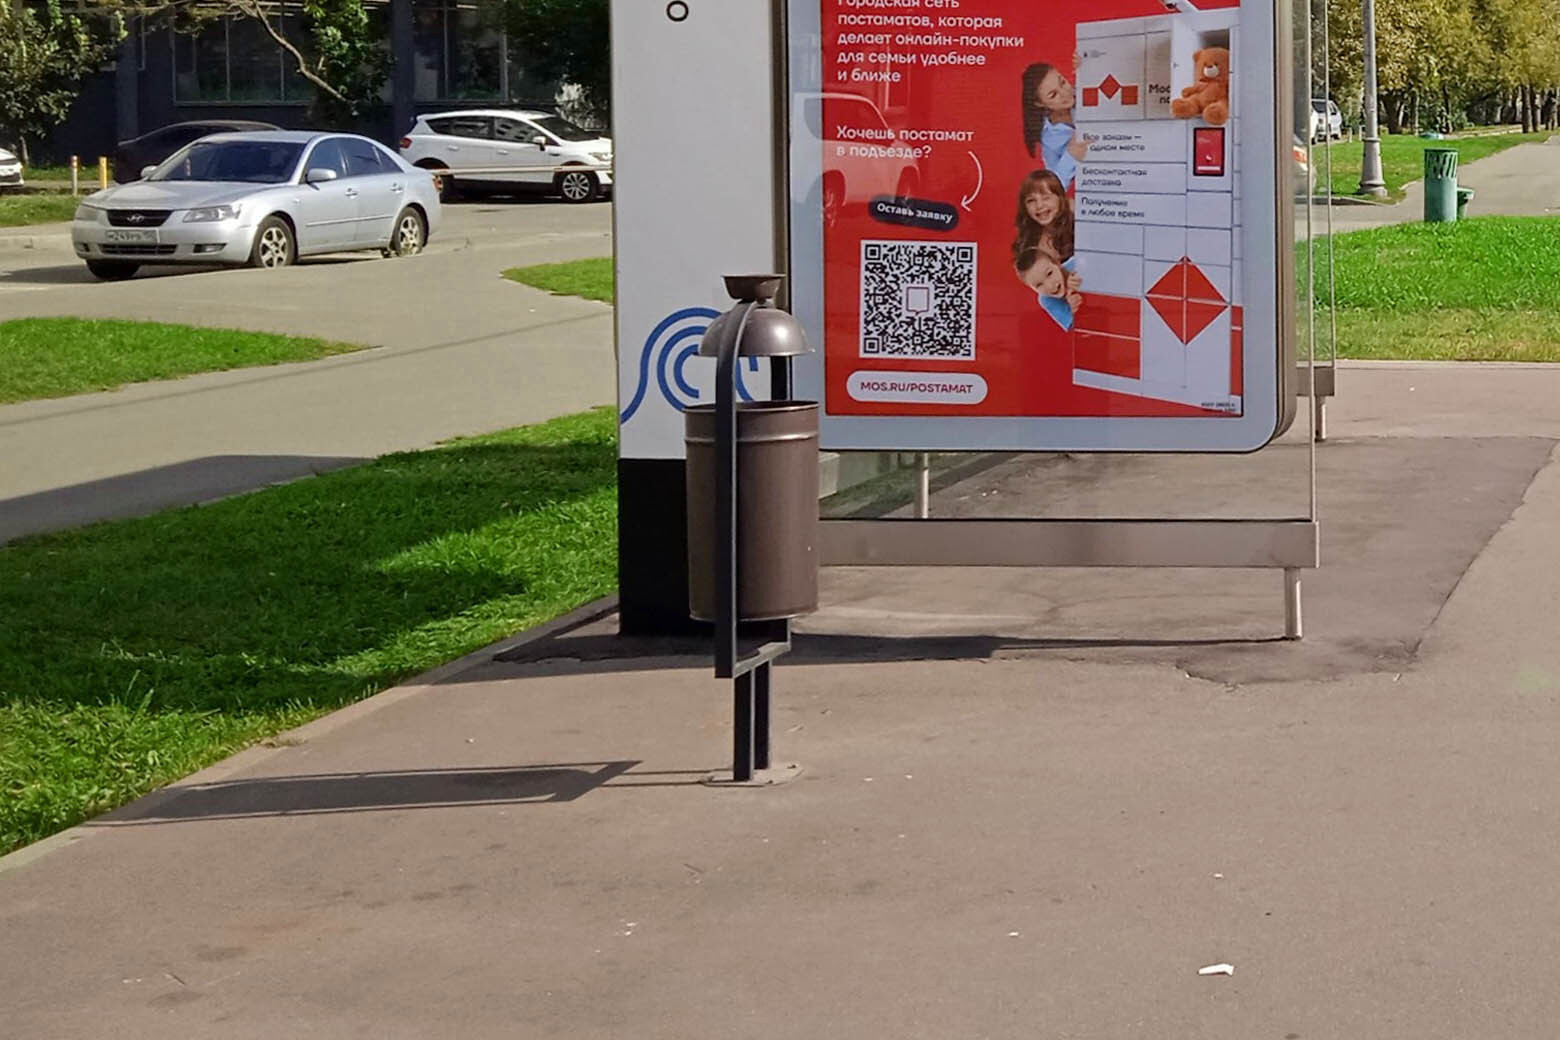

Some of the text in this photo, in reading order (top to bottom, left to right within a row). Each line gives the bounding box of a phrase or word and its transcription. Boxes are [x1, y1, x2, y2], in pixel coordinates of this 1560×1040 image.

[837, 13, 1003, 30] постаматов, которая
[837, 32, 1024, 49] делает онлайн-покупки
[837, 52, 986, 67] для семьи удобнее
[837, 68, 901, 82] и ближе
[836, 125, 975, 142] Хочешь постамат
[836, 145, 932, 159] в подъезде?
[876, 202, 953, 224] Оставь заявку
[860, 381, 974, 394] MOS.RU/POSTAMAT
